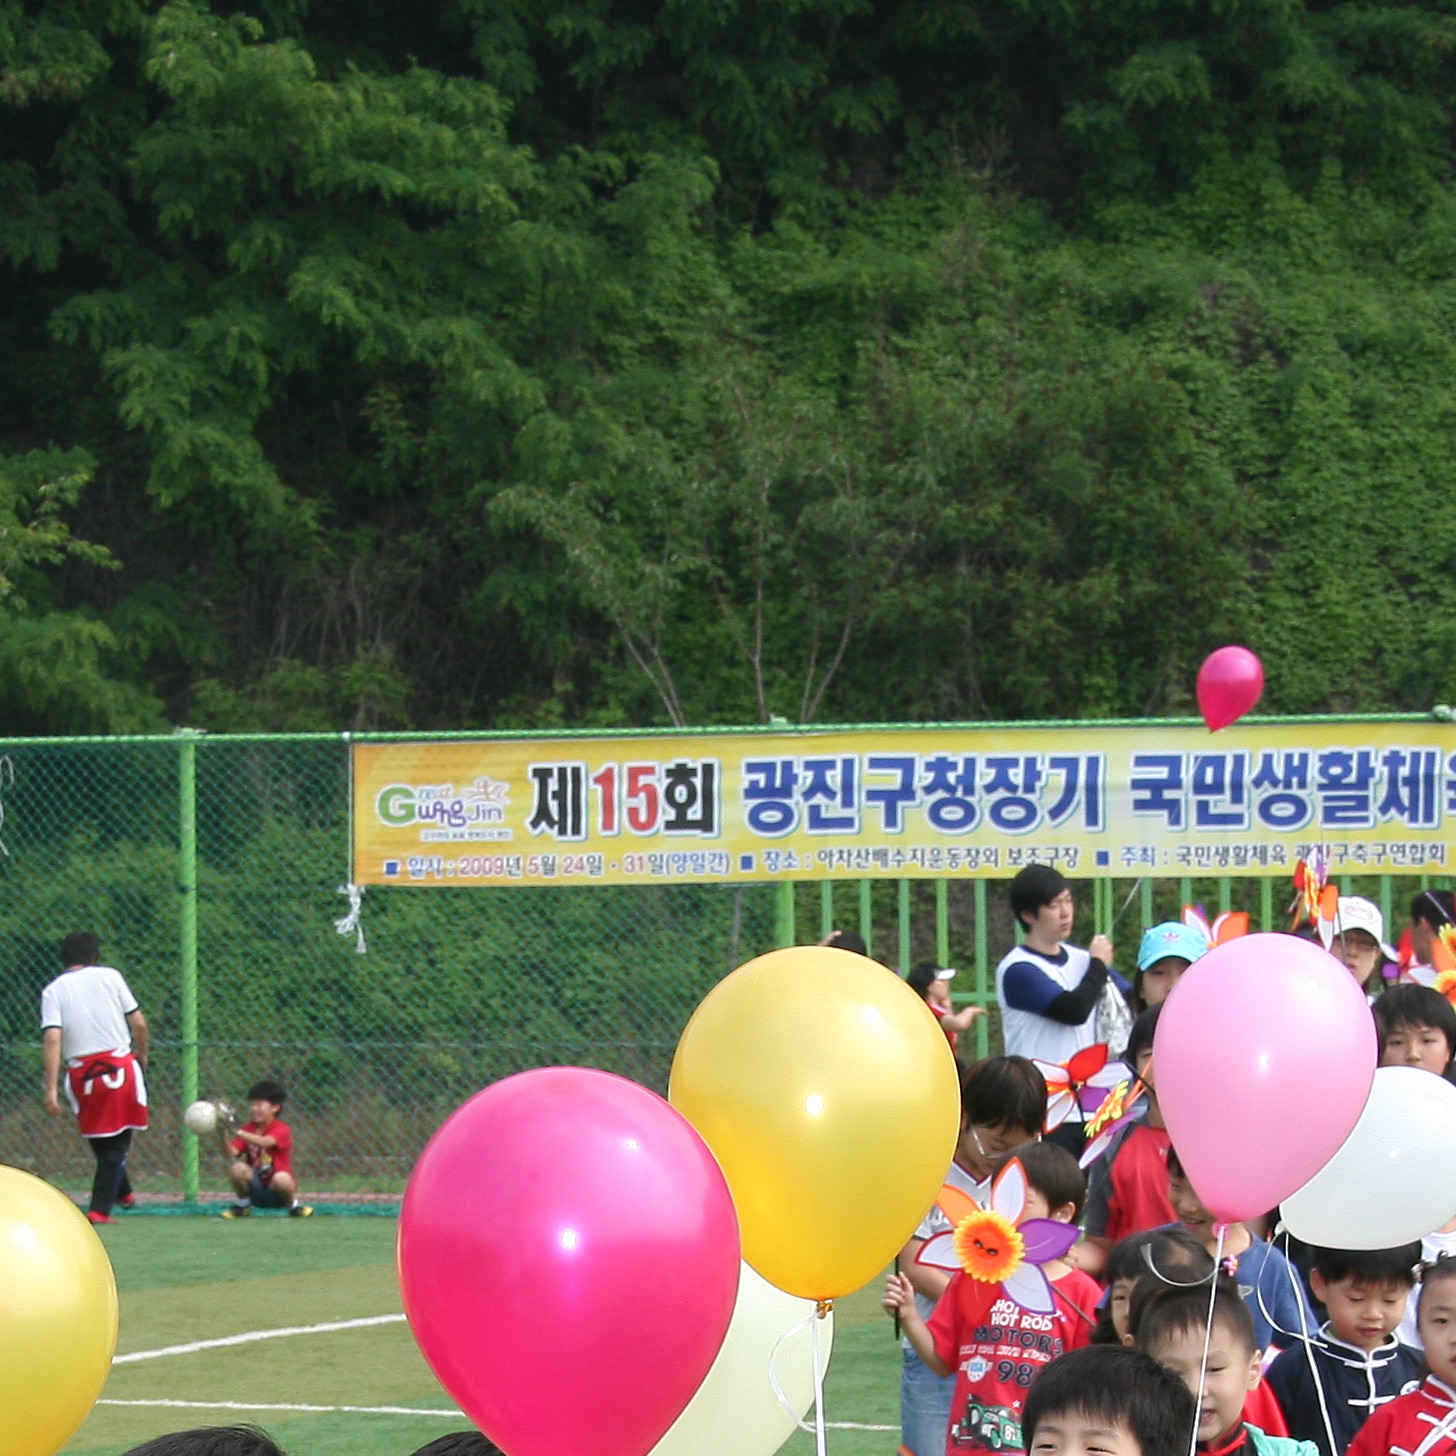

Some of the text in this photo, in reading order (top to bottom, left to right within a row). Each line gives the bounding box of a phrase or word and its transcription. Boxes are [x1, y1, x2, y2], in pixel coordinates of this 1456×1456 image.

[530, 763, 715, 839] 제15회
[745, 754, 1103, 834] 광진구청장기
[460, 856, 522, 876] 2009년
[528, 855, 557, 876] 5월
[563, 854, 603, 875] 24일
[1175, 844, 1288, 866] 국민생활체육
[974, 1324, 1064, 1356] MOTORS
